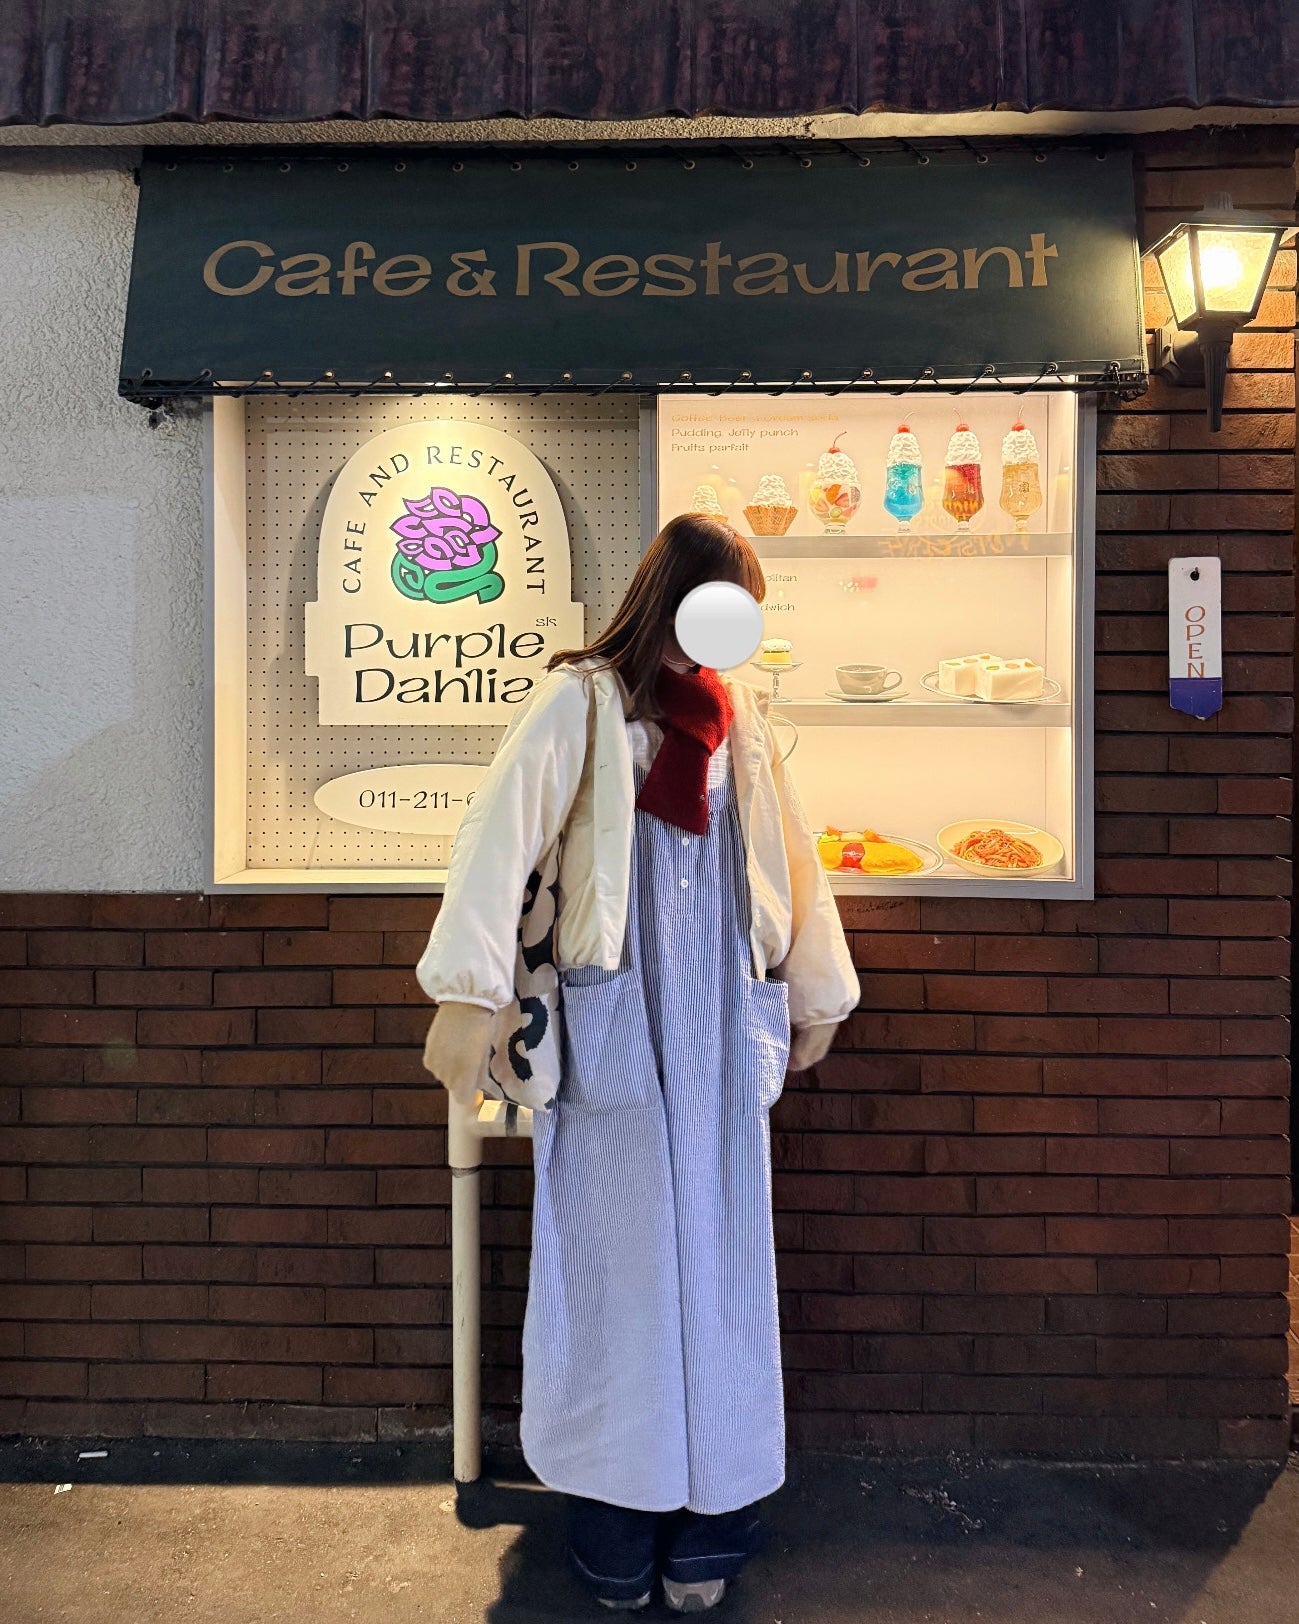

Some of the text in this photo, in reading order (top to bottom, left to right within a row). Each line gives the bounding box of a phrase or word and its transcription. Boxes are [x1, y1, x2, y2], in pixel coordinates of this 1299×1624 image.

[203, 233, 1059, 297] Cafe & Restaurant
[671, 428, 722, 438] Pudding
[760, 428, 799, 438] punch
[671, 443, 749, 453] Fruits parfait
[342, 446, 545, 595] CAFE AND RESTAURANT
[765, 574, 797, 582] olitan
[760, 603, 795, 611] dwich
[344, 623, 545, 668] Purple
[1184, 605, 1206, 679] OPEN
[355, 668, 534, 704] Dahlia
